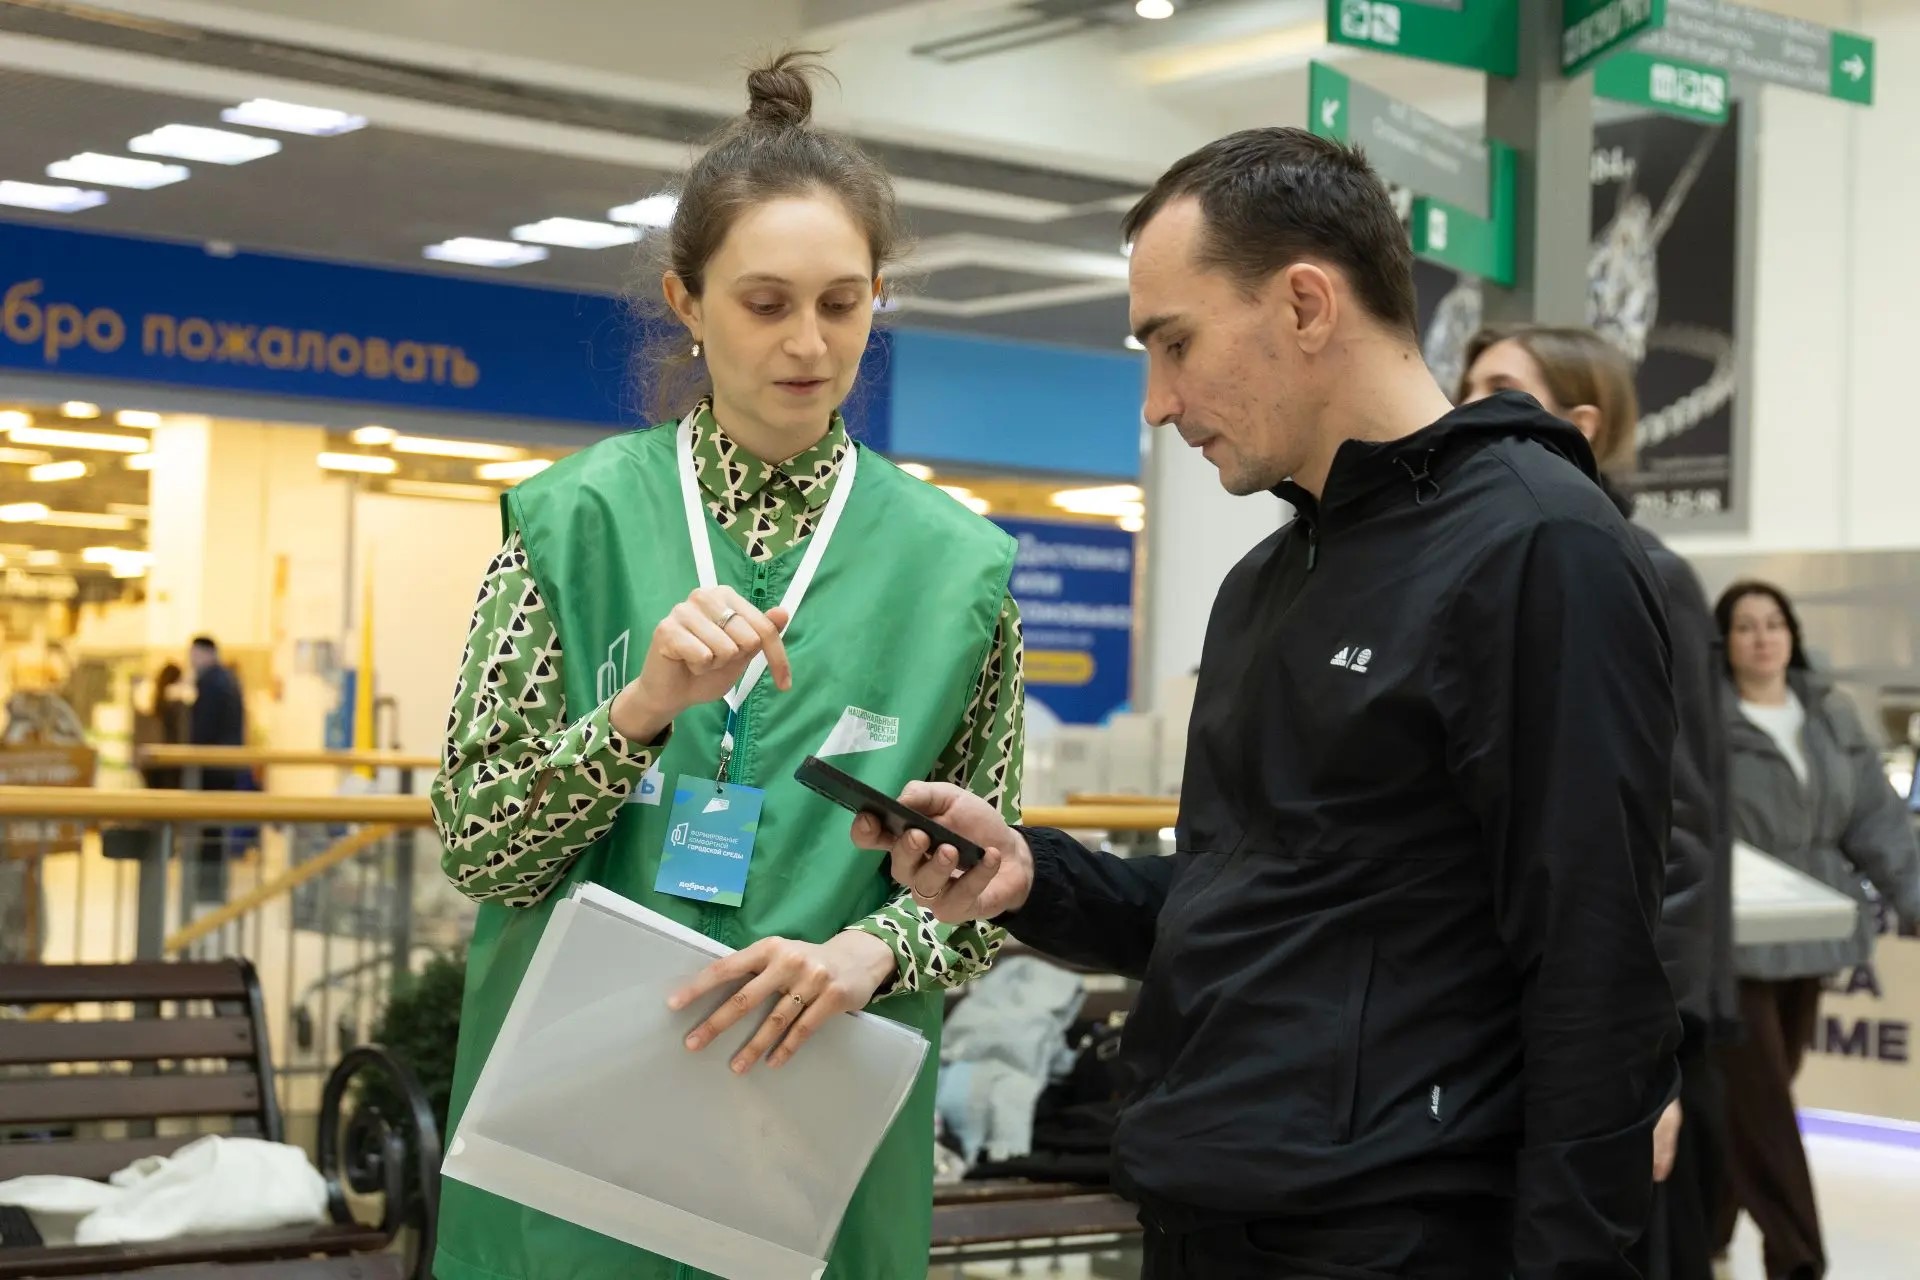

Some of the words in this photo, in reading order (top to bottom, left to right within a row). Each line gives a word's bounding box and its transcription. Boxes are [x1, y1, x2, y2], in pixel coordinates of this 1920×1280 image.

[0, 279, 125, 363] бро
[142, 313, 480, 389] пожаловать
[847, 706, 897, 727] НАЦИОНАЛЬНЫЕ
[866, 721, 897, 735] ПРОЕКТЫ
[869, 732, 896, 743] РОССИИ
[689, 837, 729, 849] КОМФОРТНОЙ
[690, 830, 739, 845] ФОРМИРОВАНИЕ
[687, 843, 722, 856] ГОРОДСКОЙ
[722, 850, 744, 860] СРЕДЫ
[678, 881, 719, 894] добро.рф
